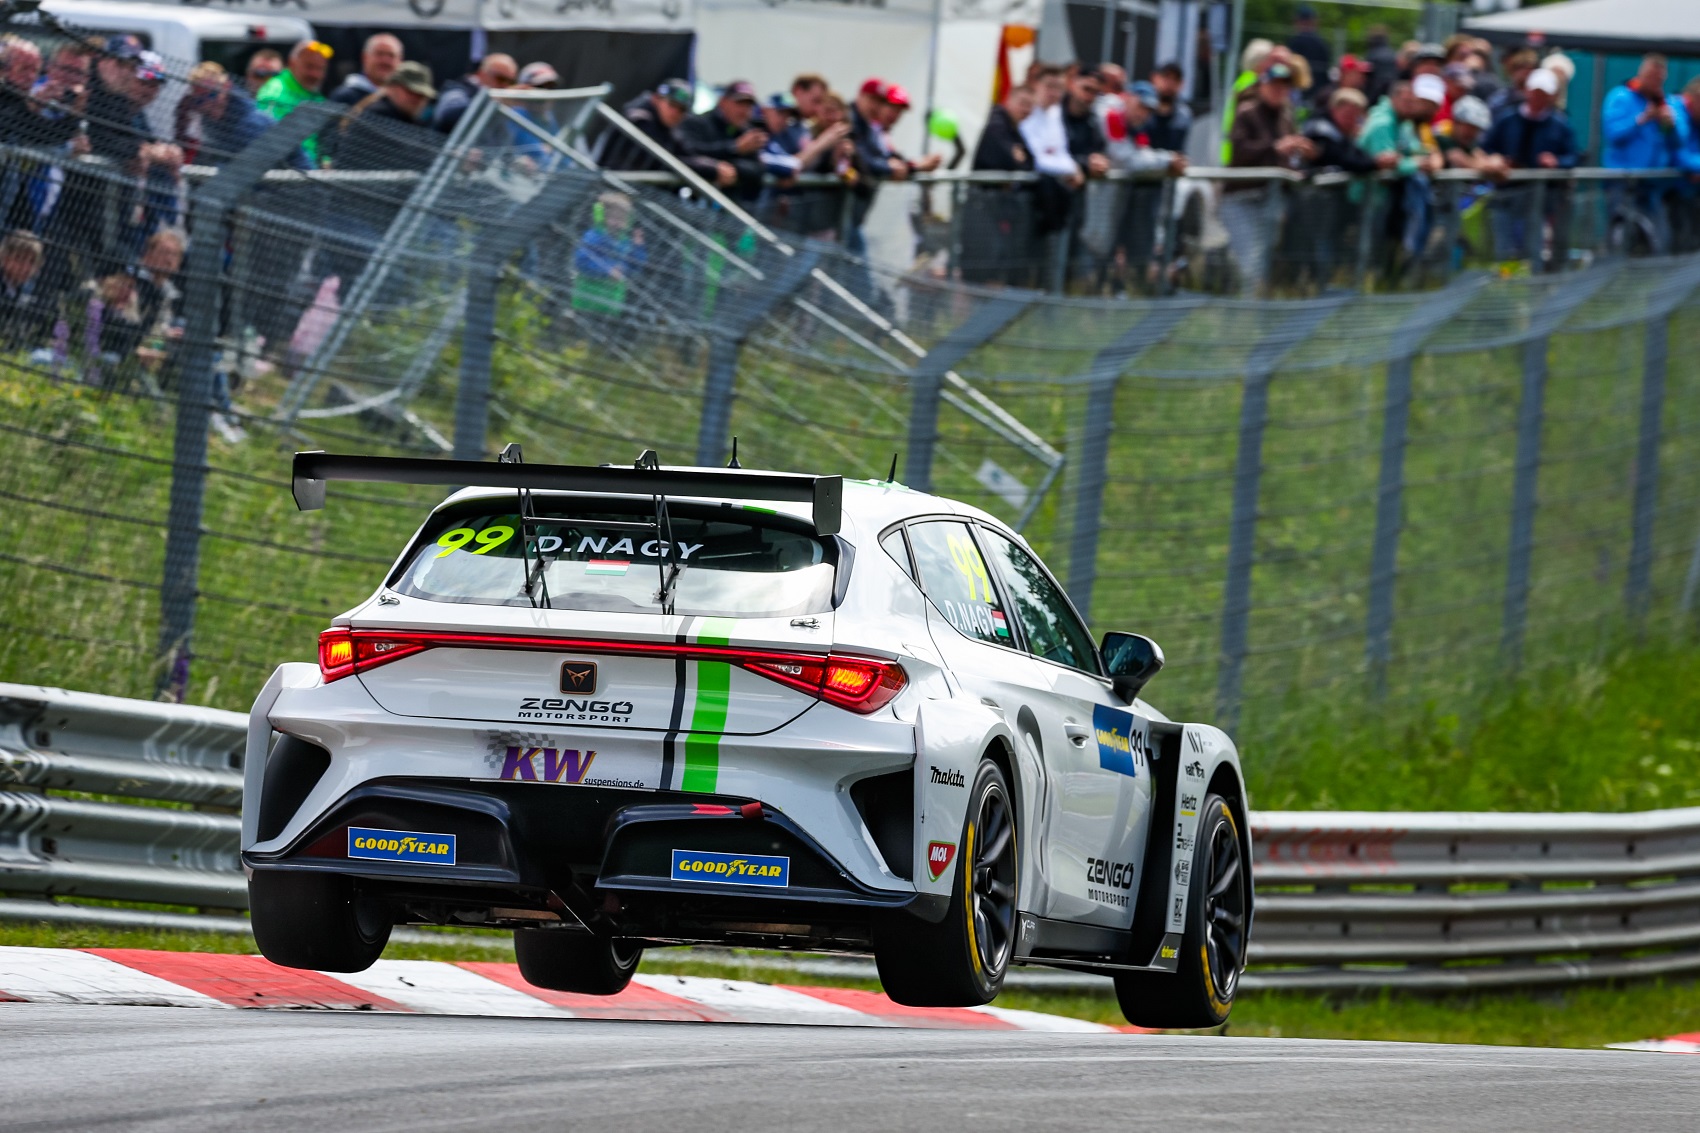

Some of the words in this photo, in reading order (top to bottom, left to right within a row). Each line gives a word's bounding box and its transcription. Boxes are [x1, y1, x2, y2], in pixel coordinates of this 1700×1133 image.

[433, 525, 515, 559] 99
[533, 535, 704, 560] D.NAGY
[946, 533, 991, 603] 99
[944, 599, 996, 638] D.NAGY
[517, 711, 631, 723] MOTORSPORT
[1131, 729, 1144, 767] 99
[500, 746, 597, 784] KW
[930, 765, 965, 788] Makita
[584, 777, 645, 789] suspensions.de
[1180, 793, 1197, 810] Hertz
[930, 846, 948, 862] MOL
[1088, 888, 1130, 907] MOTORSPORT
